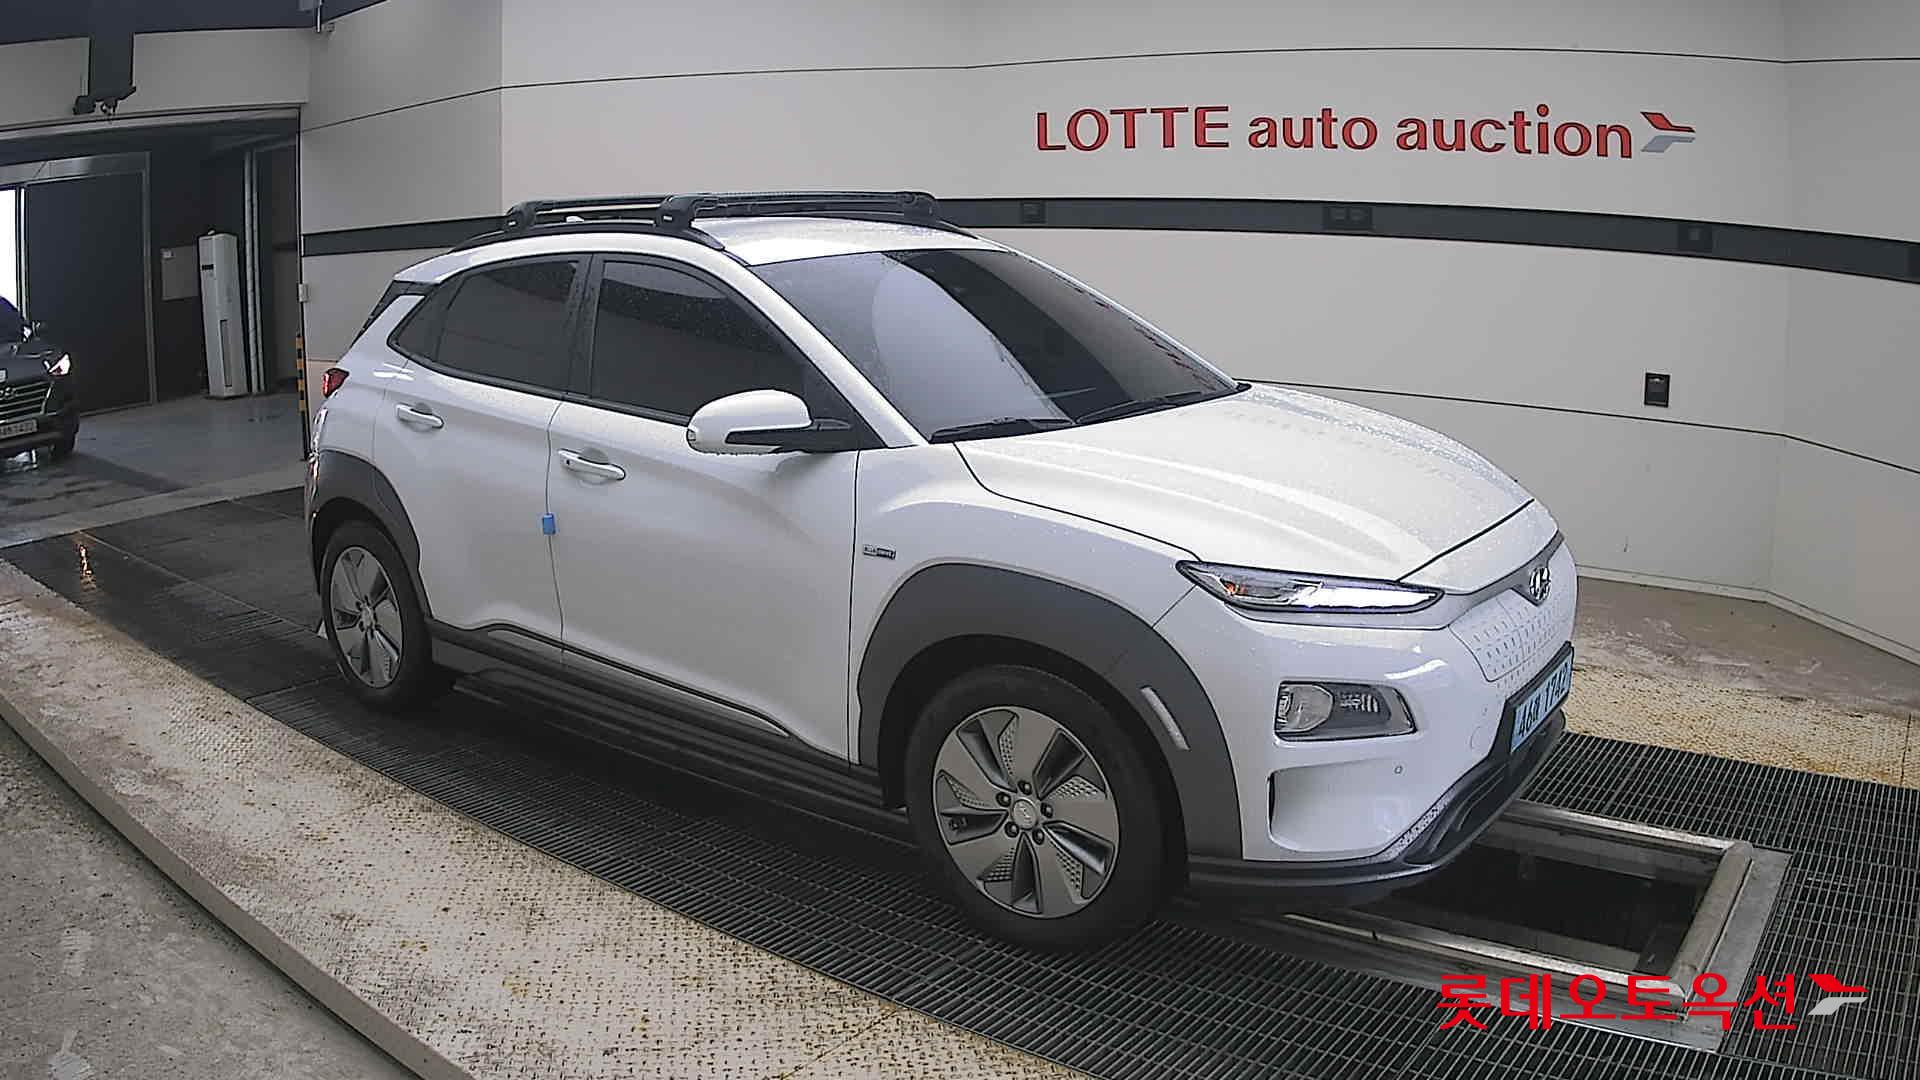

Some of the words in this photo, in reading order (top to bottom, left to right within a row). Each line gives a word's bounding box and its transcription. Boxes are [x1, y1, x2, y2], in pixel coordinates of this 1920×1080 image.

[1036, 105, 1229, 152] LOTTE
[1247, 107, 1378, 150] auto
[1396, 104, 1633, 159] auction
